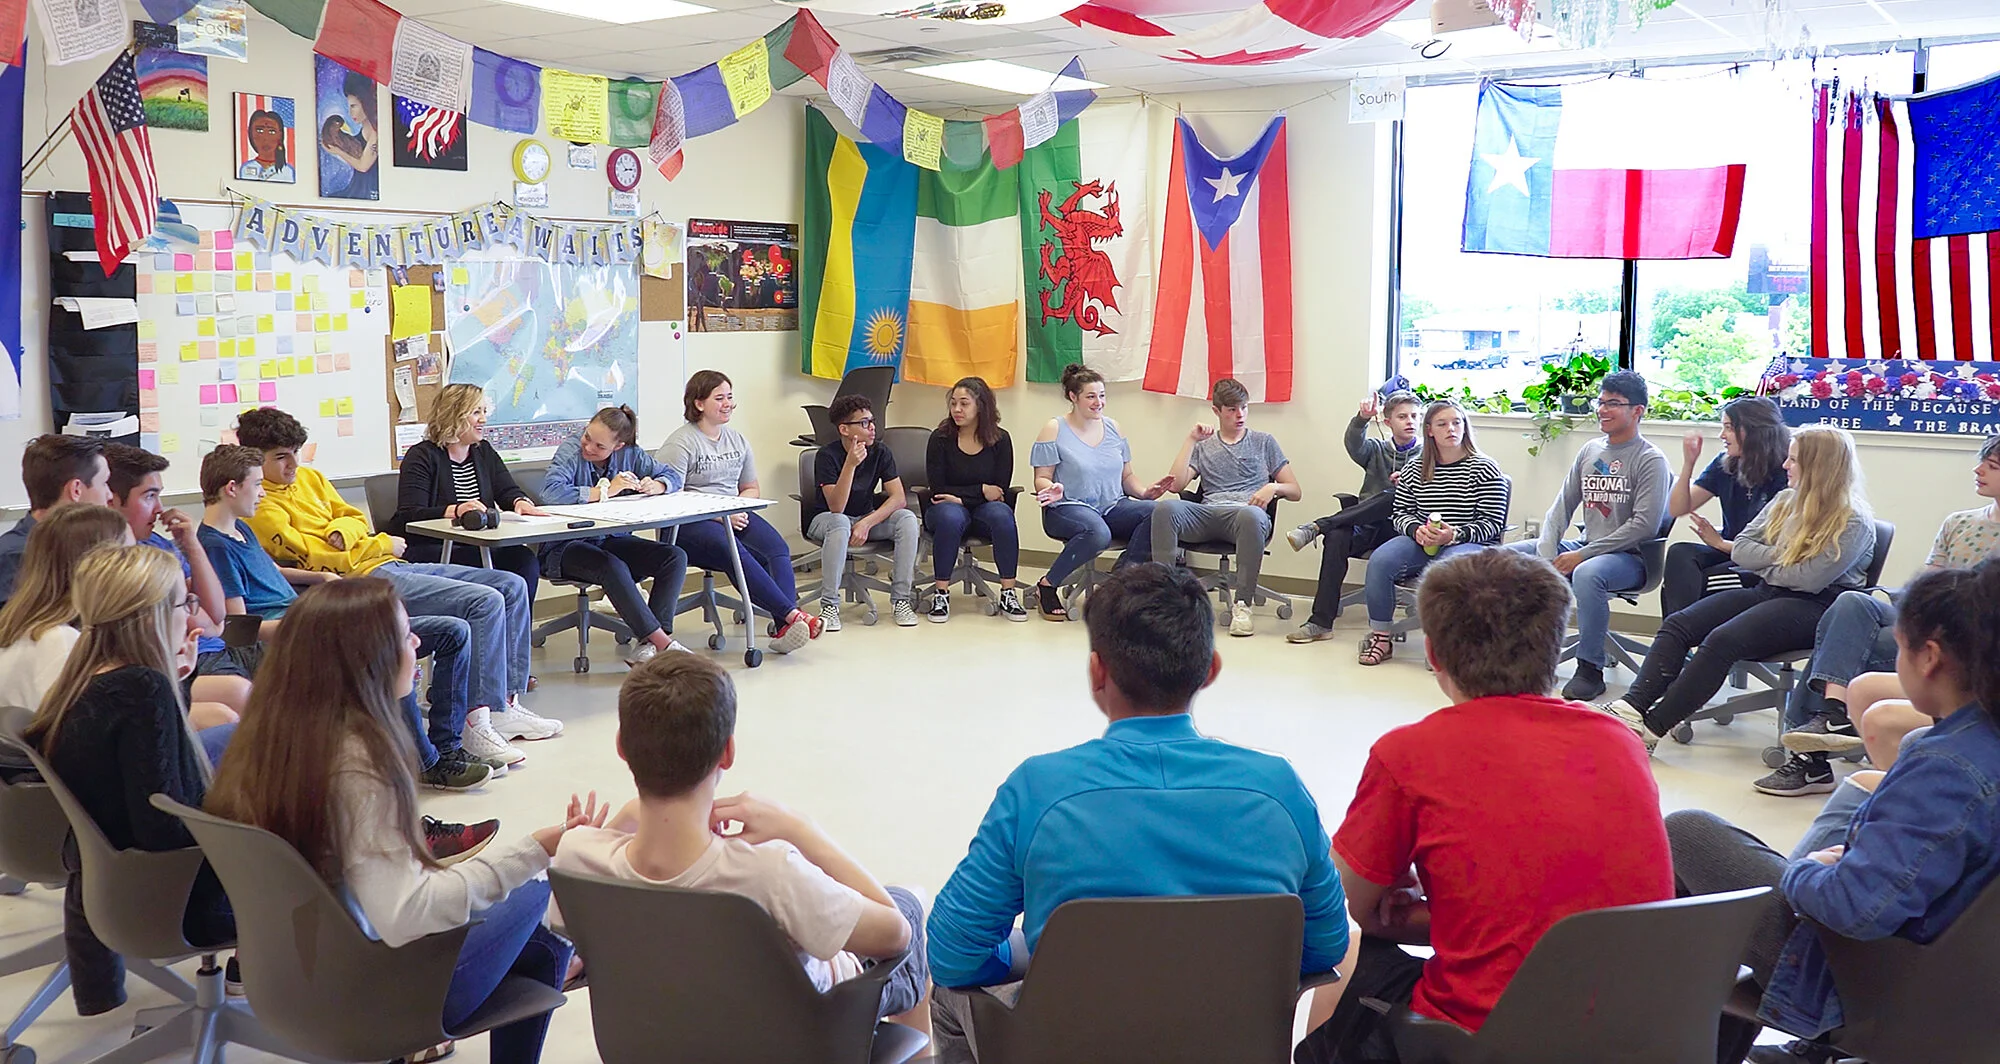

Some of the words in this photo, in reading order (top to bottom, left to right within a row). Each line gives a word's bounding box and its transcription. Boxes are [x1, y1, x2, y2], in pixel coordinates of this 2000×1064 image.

[196, 18, 229, 36] East
[1358, 91, 1397, 106] South
[246, 207, 498, 257] ADVENTURE
[509, 213, 643, 256] AWAITS
[691, 221, 729, 235] Genocide
[1779, 399, 1821, 409] LAND
[1829, 399, 1850, 410] OF
[1862, 400, 1895, 411] THE
[1910, 401, 1992, 415] BECAUSE
[1820, 417, 1862, 429] FREE
[1913, 420, 1948, 432] THE
[1958, 421, 2000, 435] BRAV
[698, 450, 741, 462] HAUNTED
[1582, 476, 1631, 492] EGIONAL
